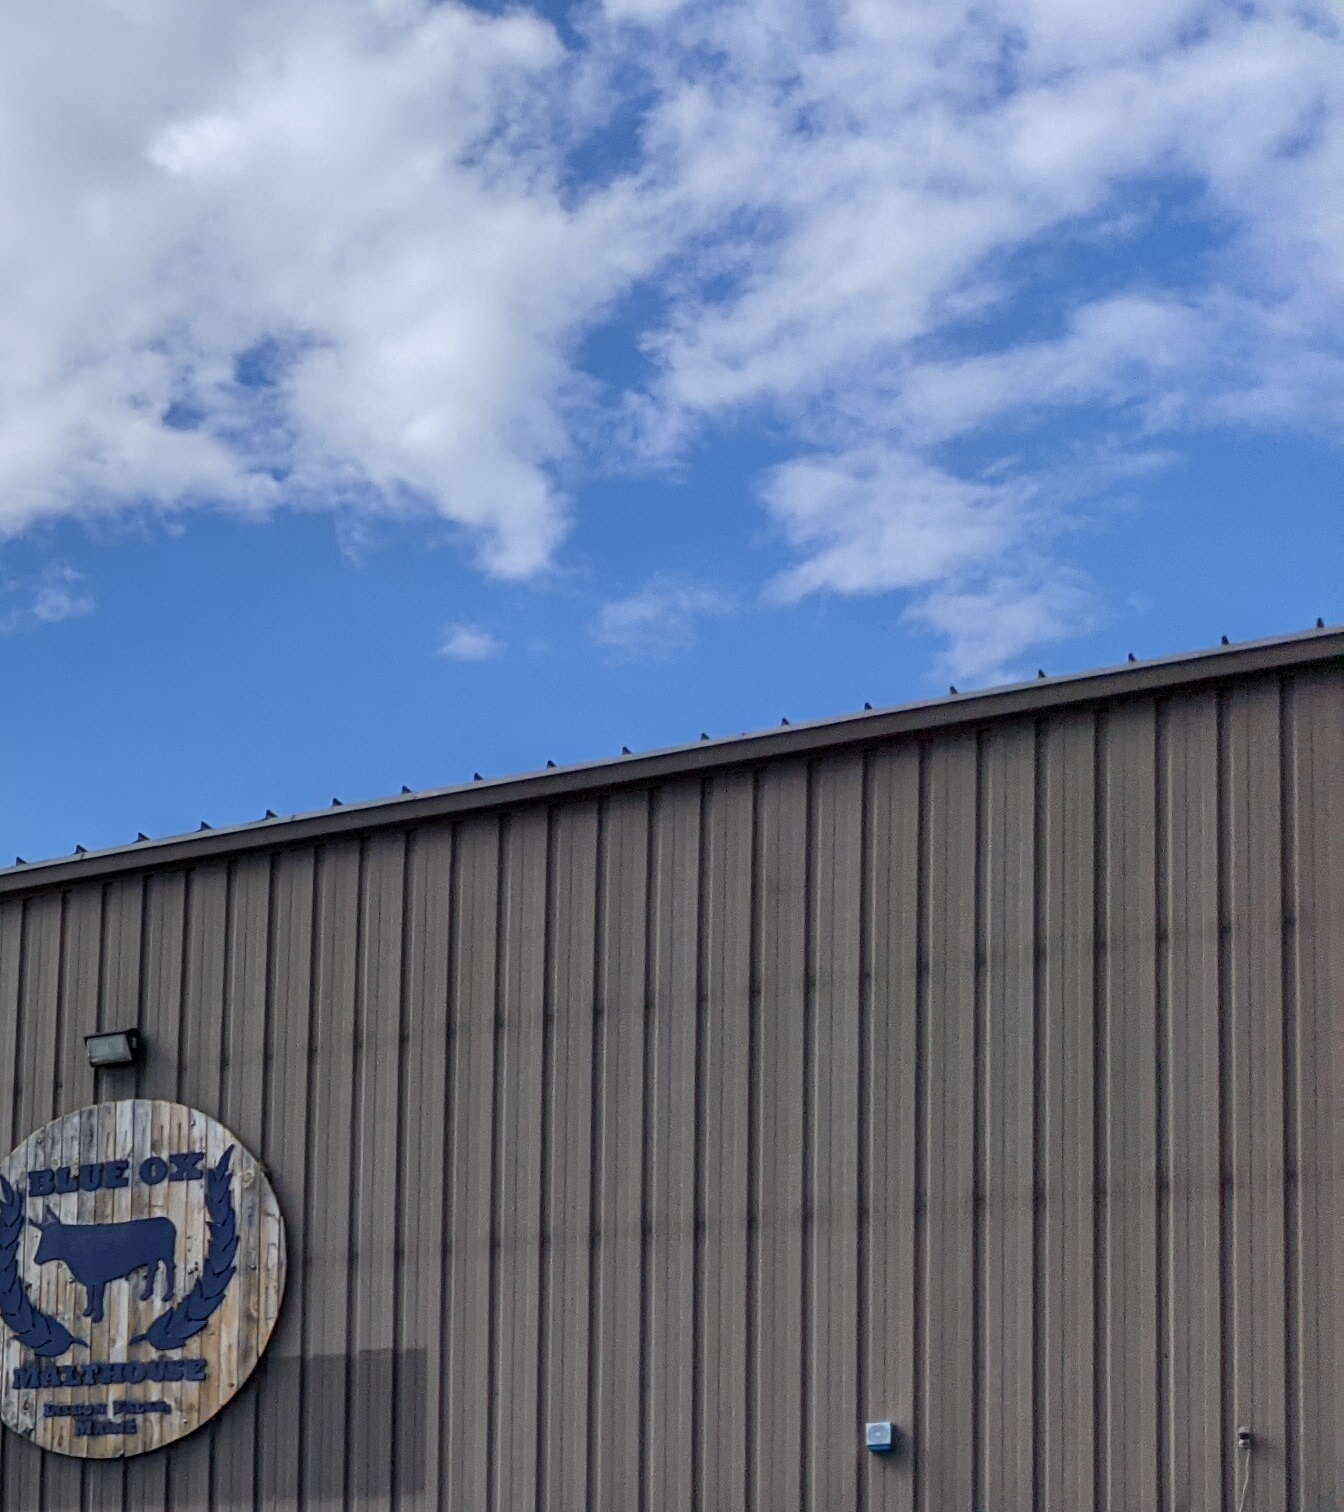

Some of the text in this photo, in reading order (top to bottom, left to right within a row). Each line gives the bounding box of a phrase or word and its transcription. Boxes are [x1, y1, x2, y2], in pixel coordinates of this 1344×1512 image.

[28, 1151, 205, 1197] BLUE OX
[12, 1359, 207, 1390] MALTHOUSE
